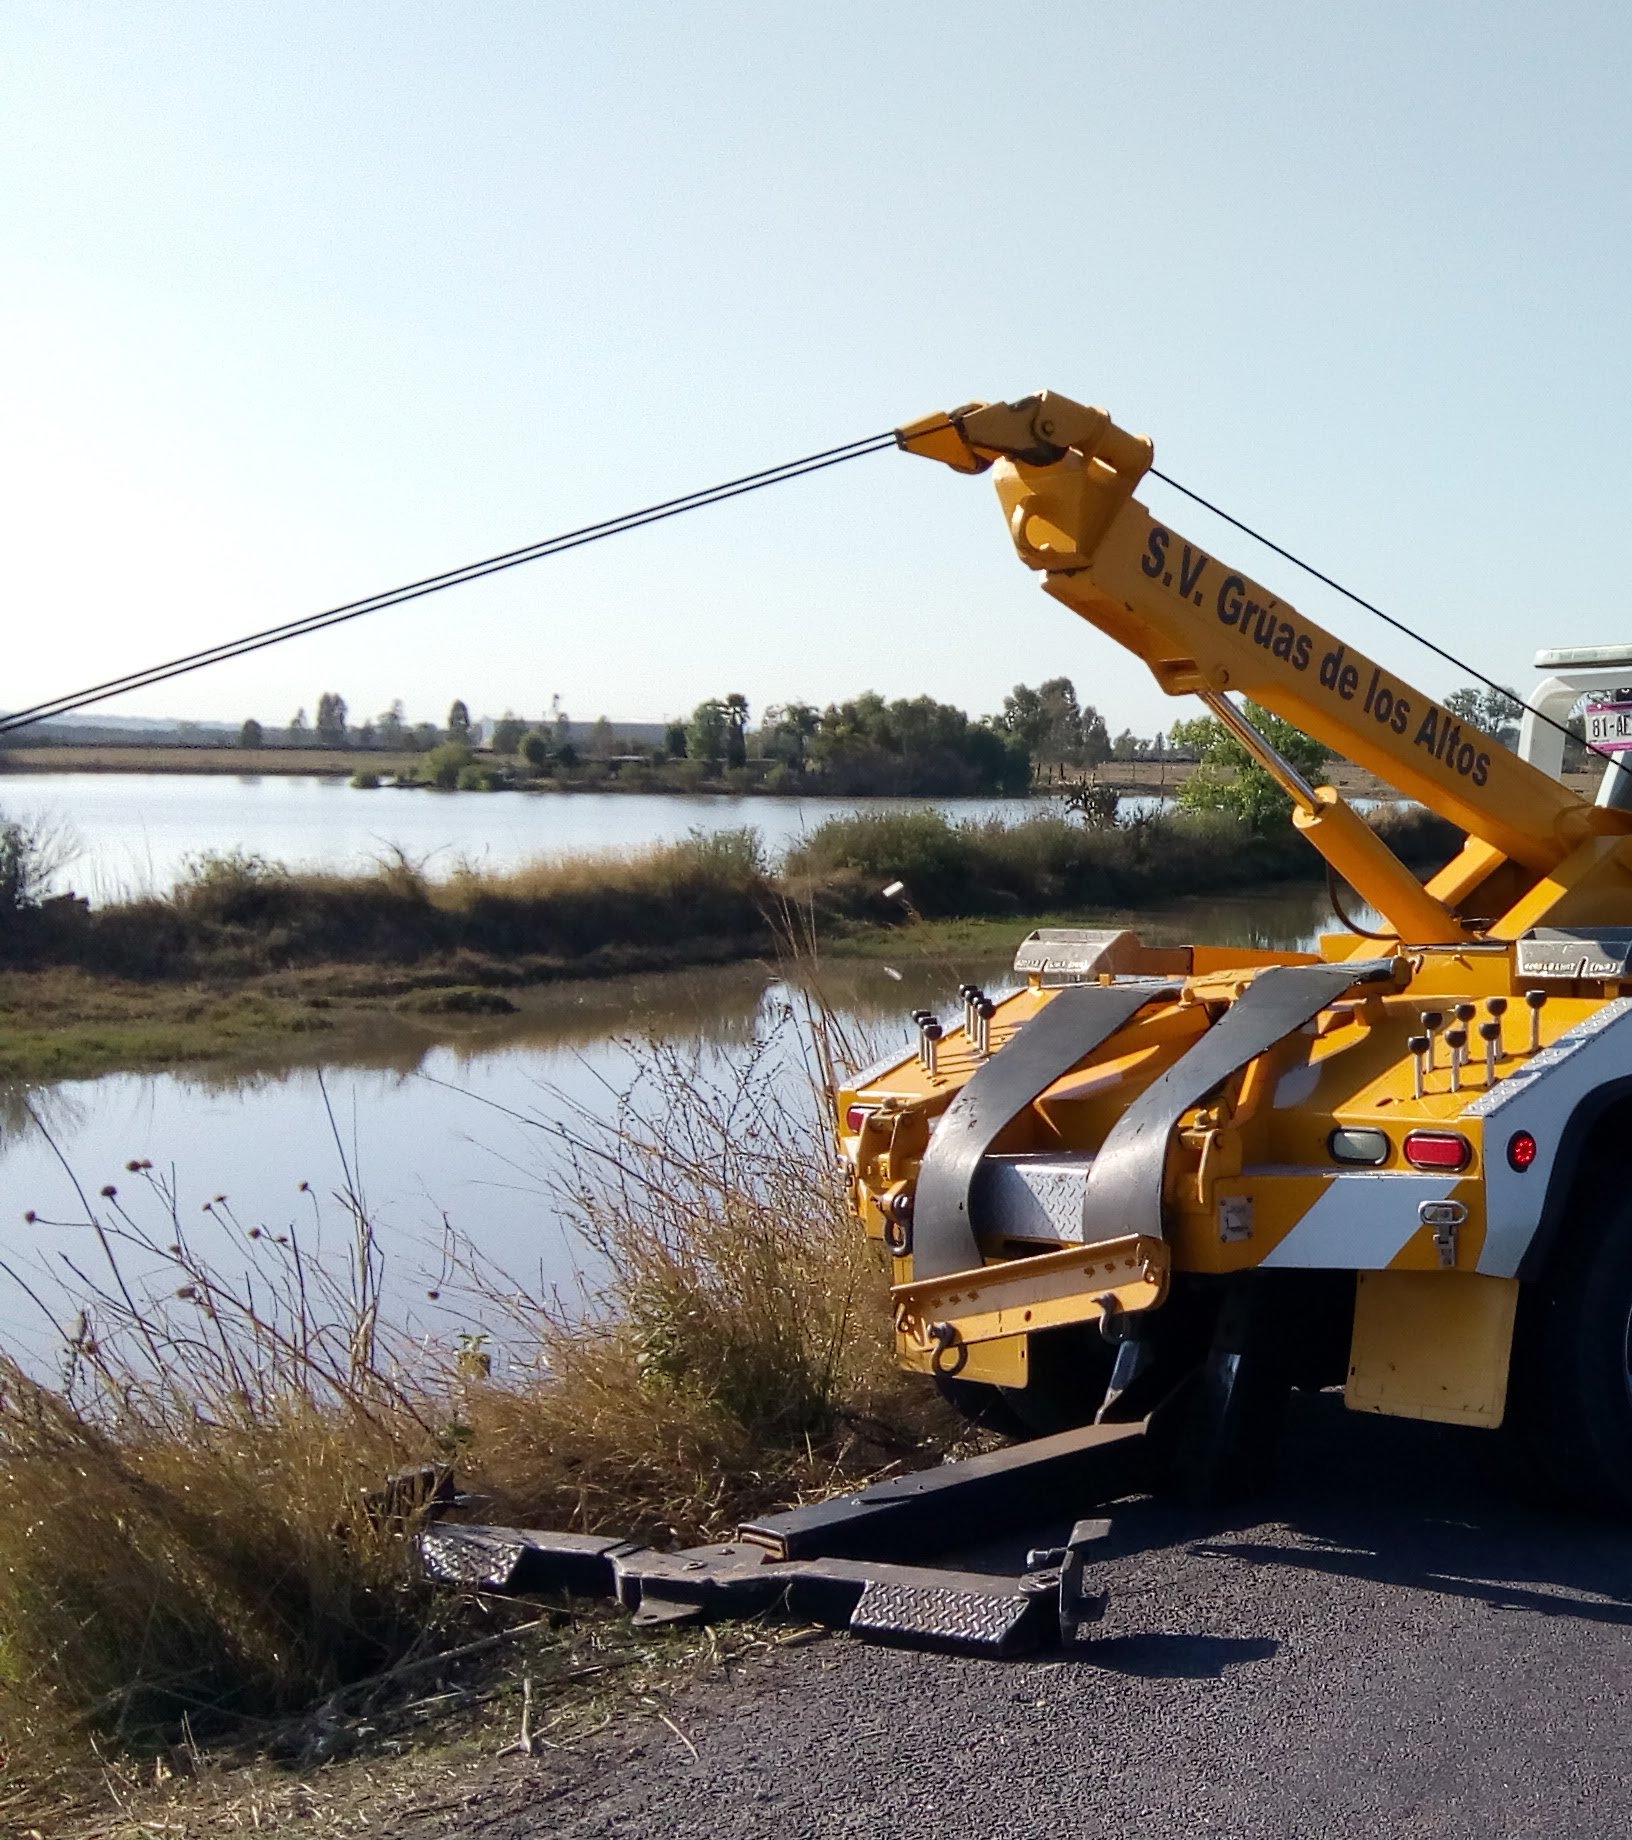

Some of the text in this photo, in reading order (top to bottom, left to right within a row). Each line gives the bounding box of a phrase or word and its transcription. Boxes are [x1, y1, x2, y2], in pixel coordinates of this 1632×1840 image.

[1141, 527, 1492, 787] S.V. Grúas de los Altos
